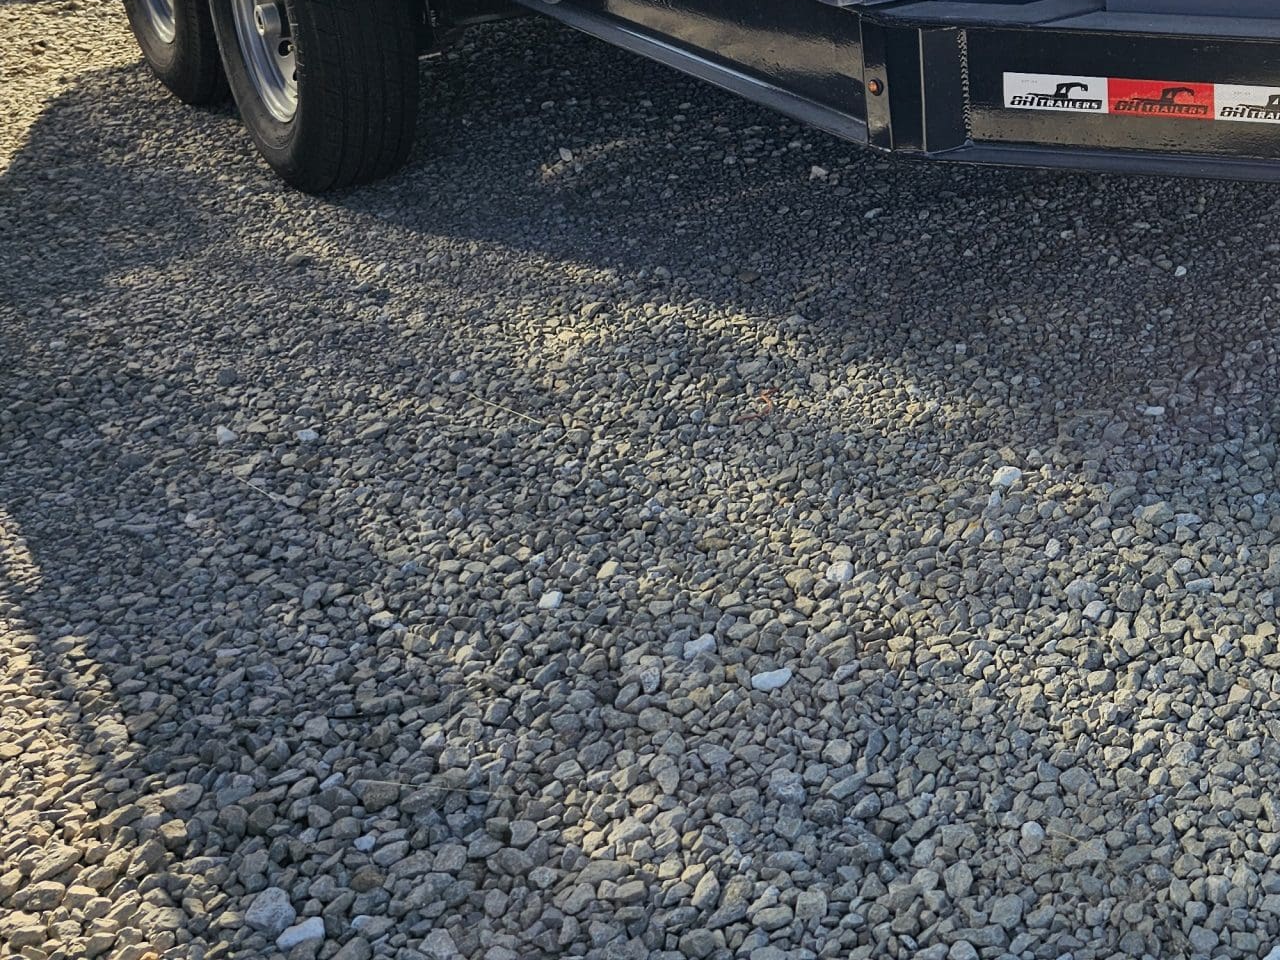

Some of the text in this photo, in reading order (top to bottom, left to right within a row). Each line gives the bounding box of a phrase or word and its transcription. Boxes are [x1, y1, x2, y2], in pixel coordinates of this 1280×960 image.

[1010, 95, 1099, 109] DH TRAILERS
[1115, 100, 1206, 115] DH TRAILERS
[1220, 106, 1247, 117] DH
